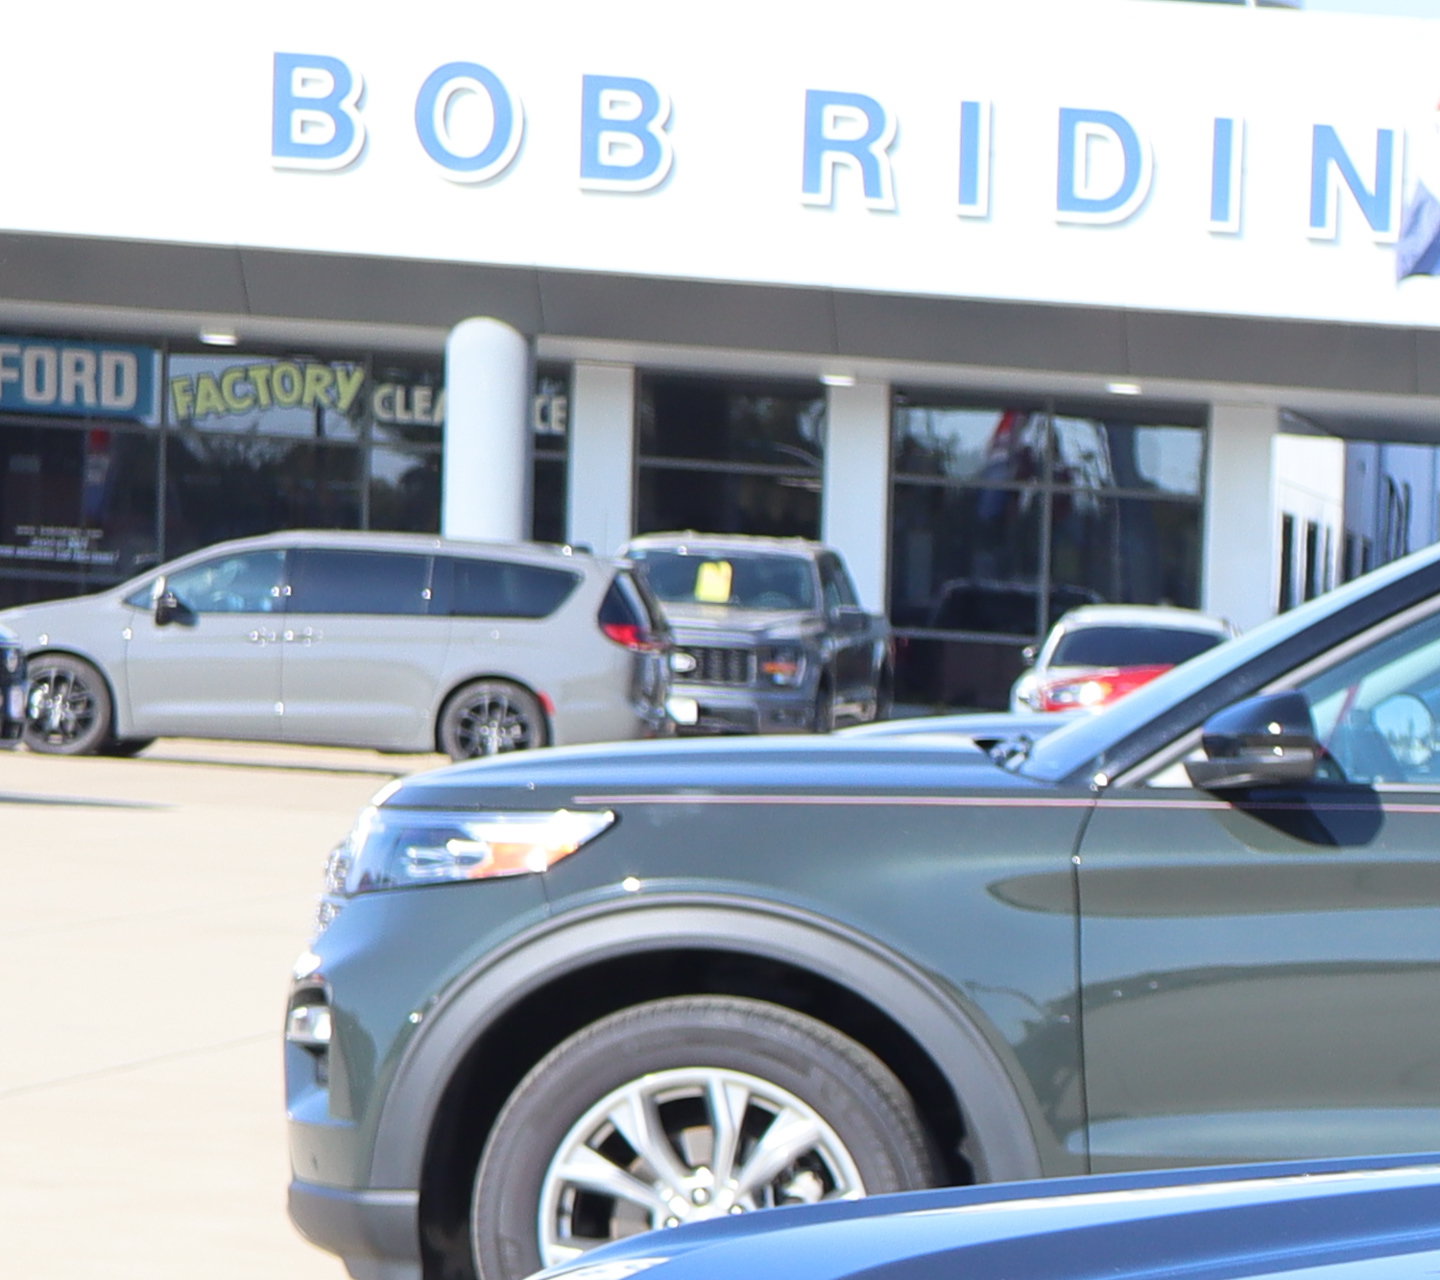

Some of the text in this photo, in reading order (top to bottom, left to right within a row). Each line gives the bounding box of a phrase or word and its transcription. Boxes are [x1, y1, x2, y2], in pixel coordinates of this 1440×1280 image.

[271, 52, 668, 188] BOB
[0, 345, 138, 410] FORD
[171, 361, 366, 421] FACTORY
